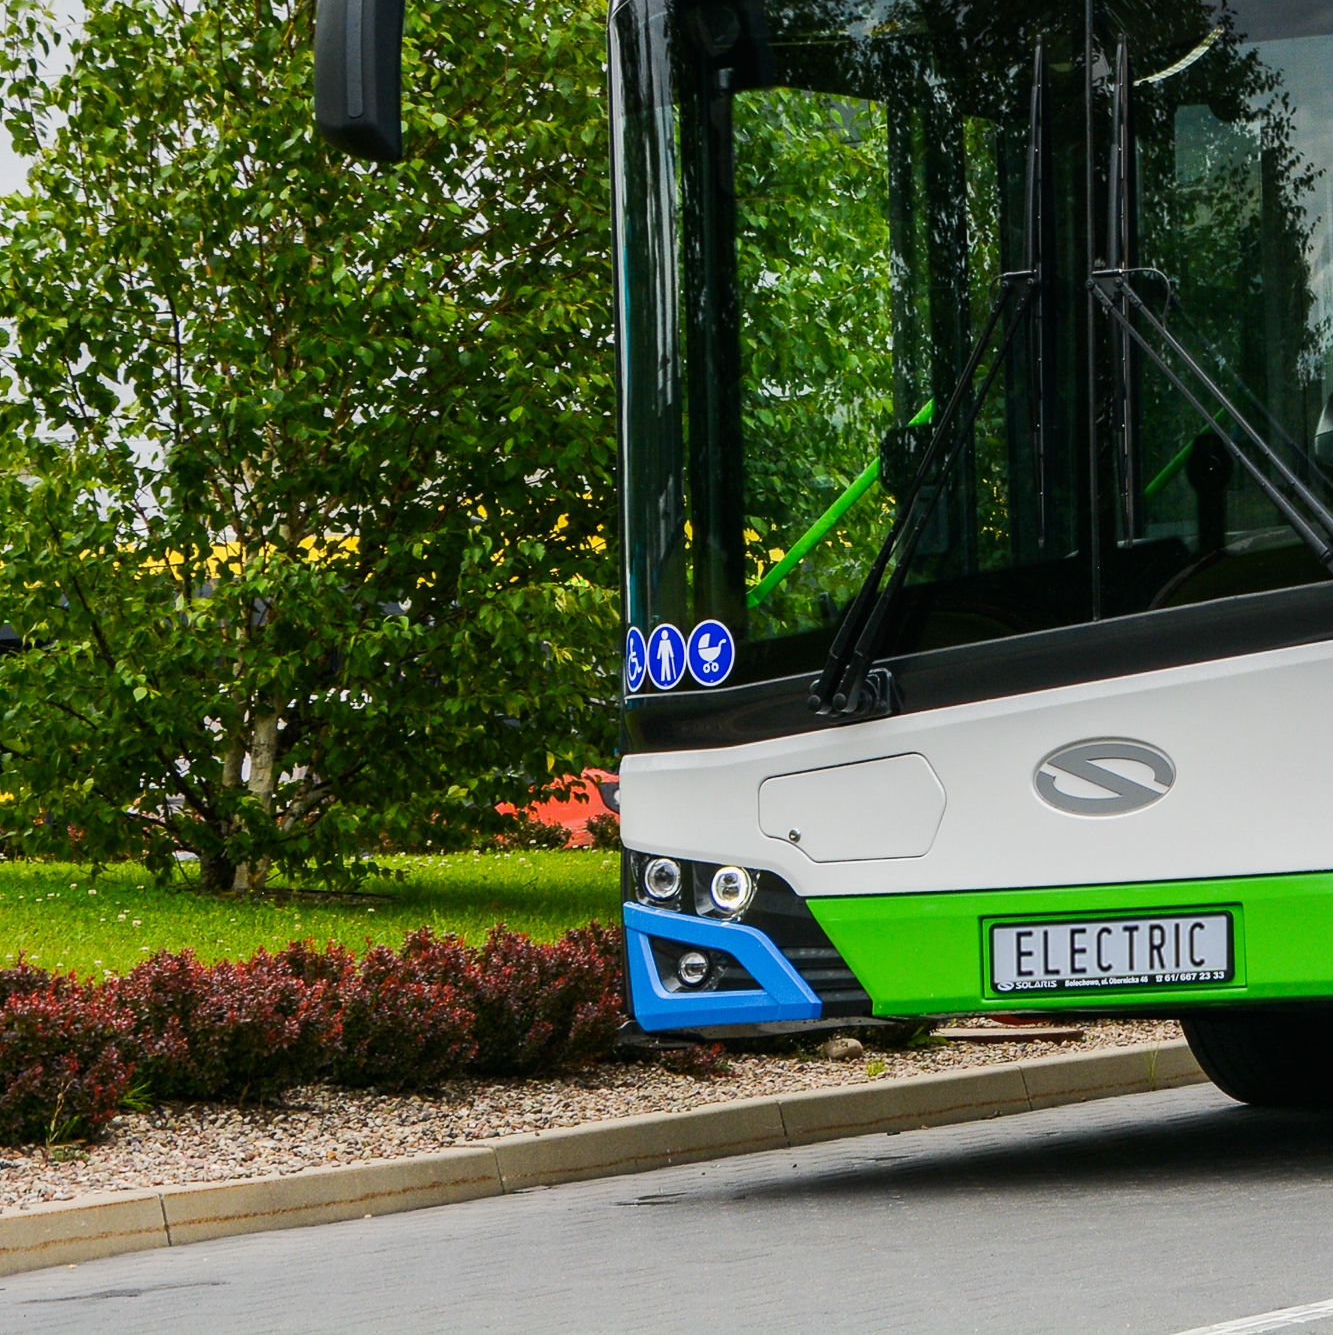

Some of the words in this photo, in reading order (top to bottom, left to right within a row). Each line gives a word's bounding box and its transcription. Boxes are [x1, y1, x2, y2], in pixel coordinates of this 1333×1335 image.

[1015, 922, 1205, 977] ELECTRIC
[1015, 980, 1057, 989] SOLARIS
[1199, 972, 1211, 980] 23
[1213, 971, 1224, 979] 33
